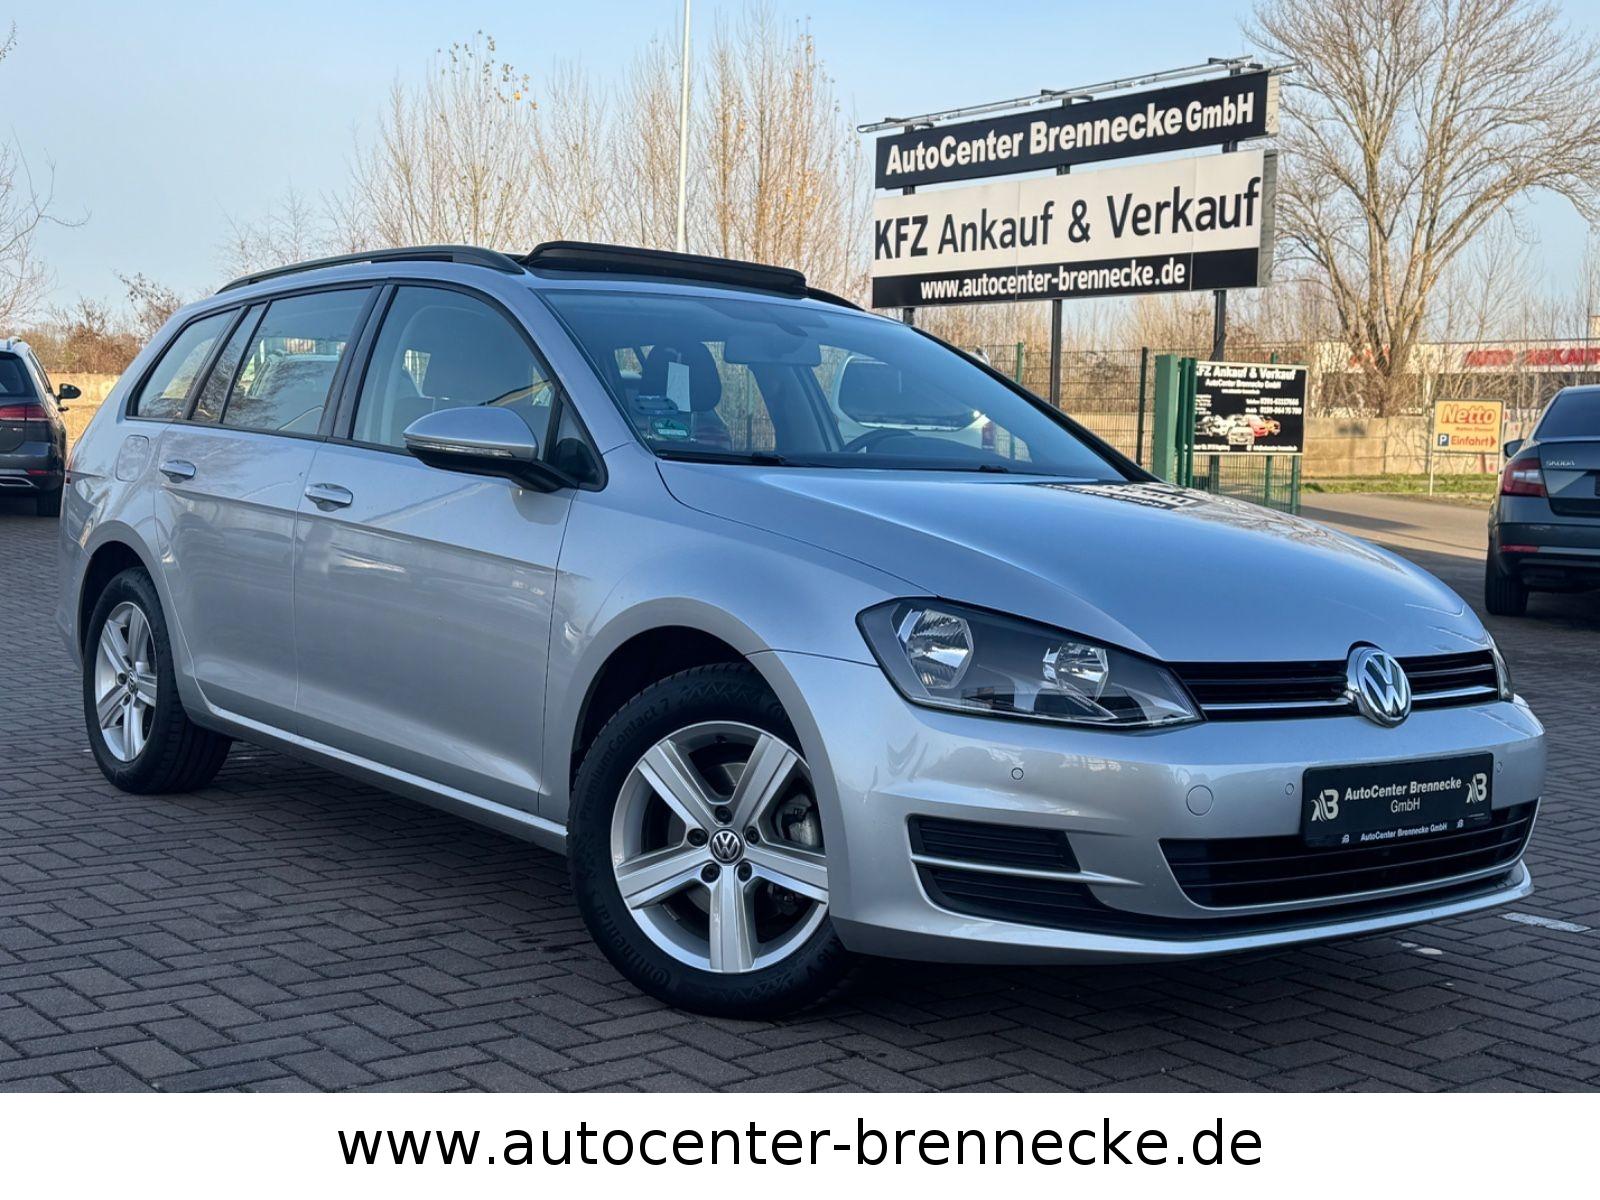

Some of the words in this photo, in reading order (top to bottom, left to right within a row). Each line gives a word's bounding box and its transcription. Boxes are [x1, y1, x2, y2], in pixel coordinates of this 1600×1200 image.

[885, 129, 1024, 176] AutoCenter
[1029, 102, 1183, 155] Brennecke
[1185, 91, 1255, 132] GmbH
[874, 214, 928, 261] KFZ
[937, 200, 1055, 255] Ankauf
[1068, 199, 1091, 244] &
[1106, 176, 1261, 239] Verkauf
[920, 257, 1186, 300] www.autocenter-brennecke.de
[1440, 403, 1497, 424] Netto
[1451, 435, 1489, 446] Einfahrt
[1344, 783, 1408, 801] AutoCenter
[1409, 776, 1462, 795] Brennecke
[1390, 797, 1421, 814] GmbH
[1360, 829, 1396, 842] AutoCenter
